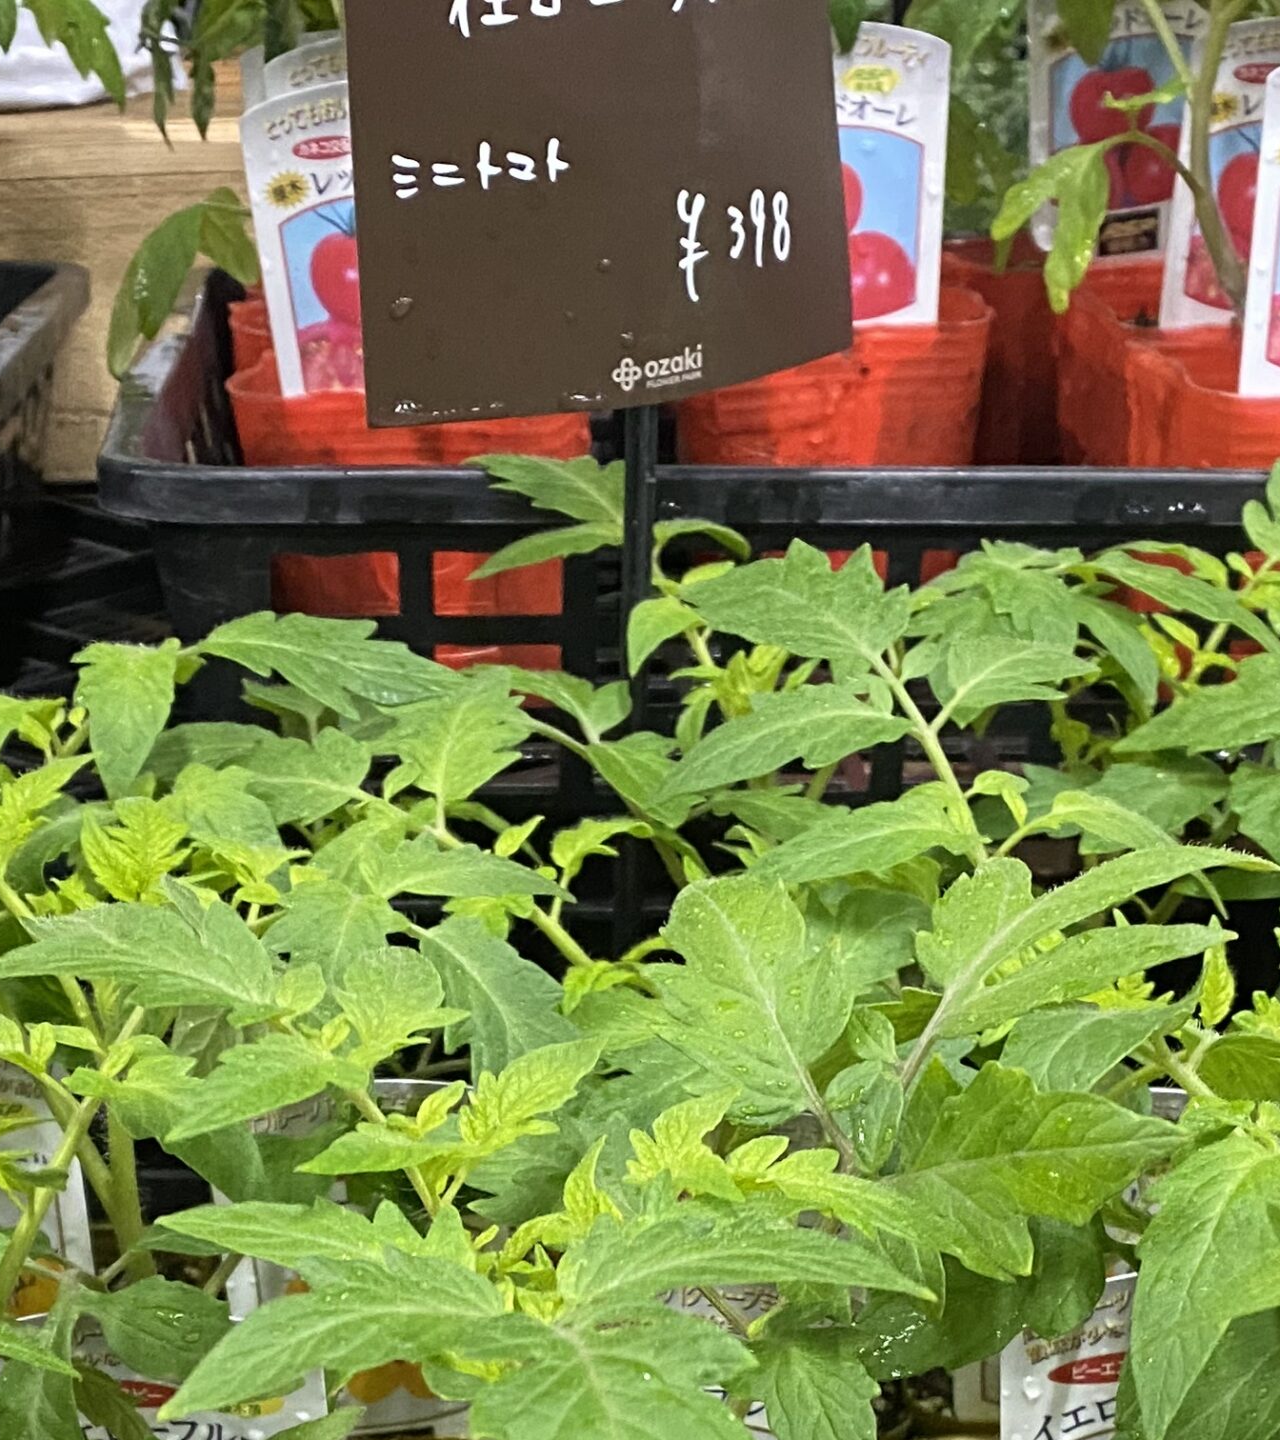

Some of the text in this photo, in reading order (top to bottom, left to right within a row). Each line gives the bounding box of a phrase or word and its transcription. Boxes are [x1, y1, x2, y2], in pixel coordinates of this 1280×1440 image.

[391, 137, 570, 199] ミニトマト
[644, 343, 703, 378] ozaki
